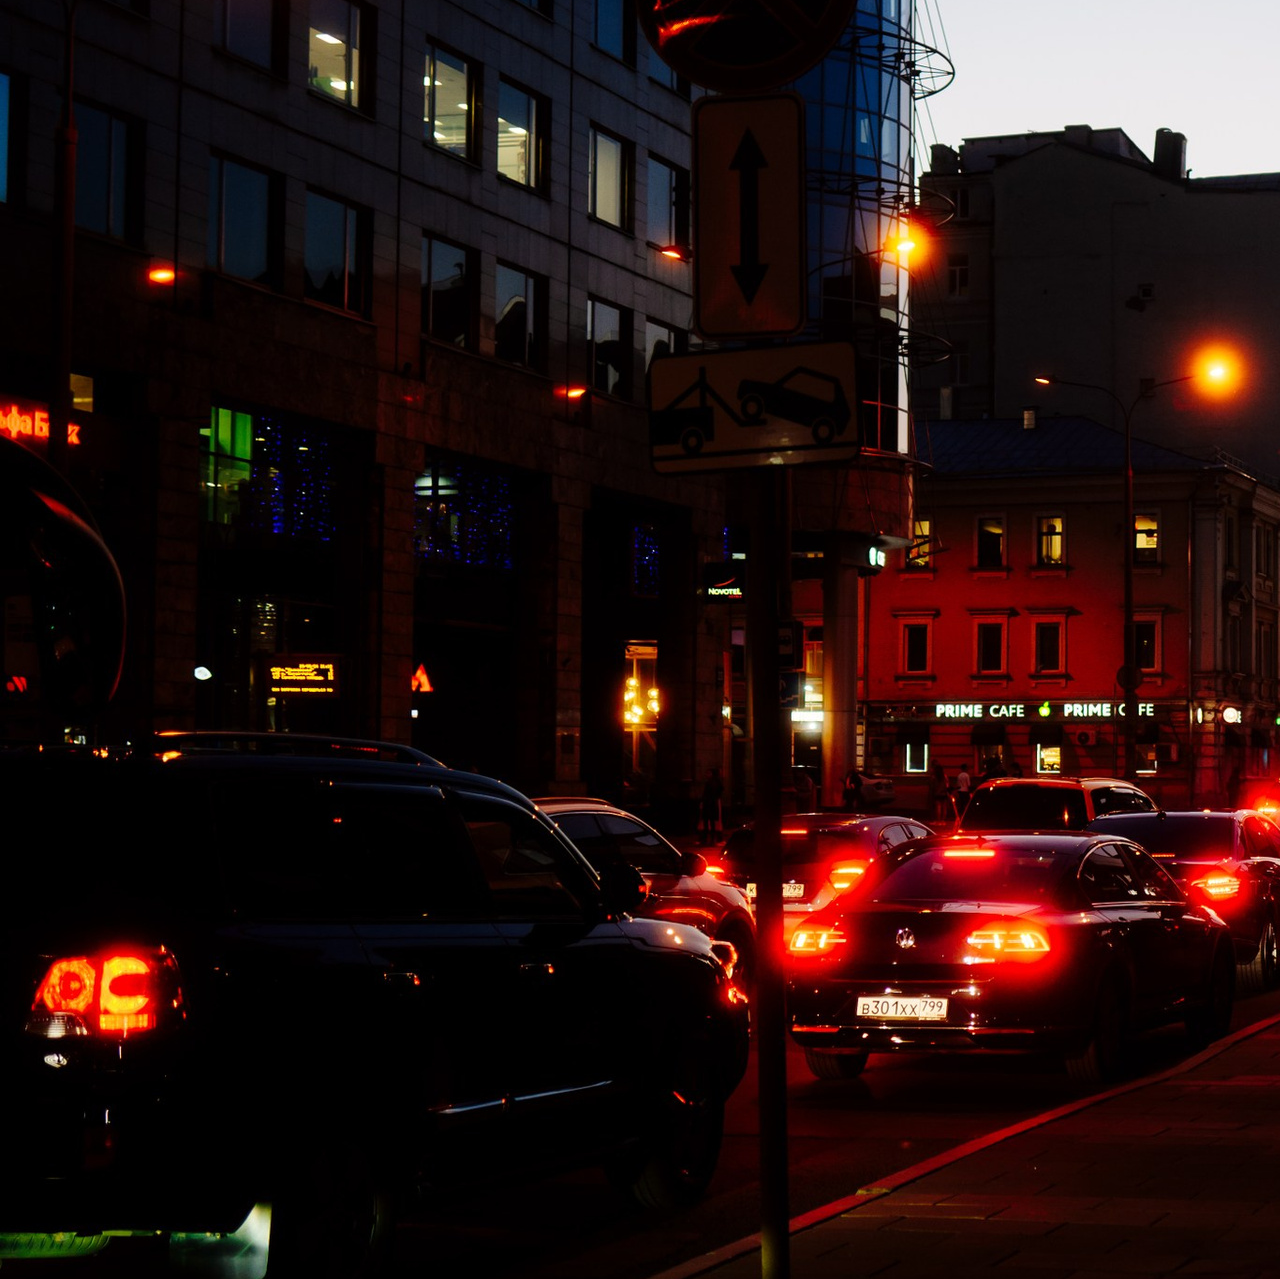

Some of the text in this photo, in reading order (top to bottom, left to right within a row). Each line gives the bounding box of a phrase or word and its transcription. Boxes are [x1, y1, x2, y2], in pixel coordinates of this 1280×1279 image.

[936, 704, 1025, 718] PRIME CAFE
[1063, 703, 1154, 717] PRIME CFE
